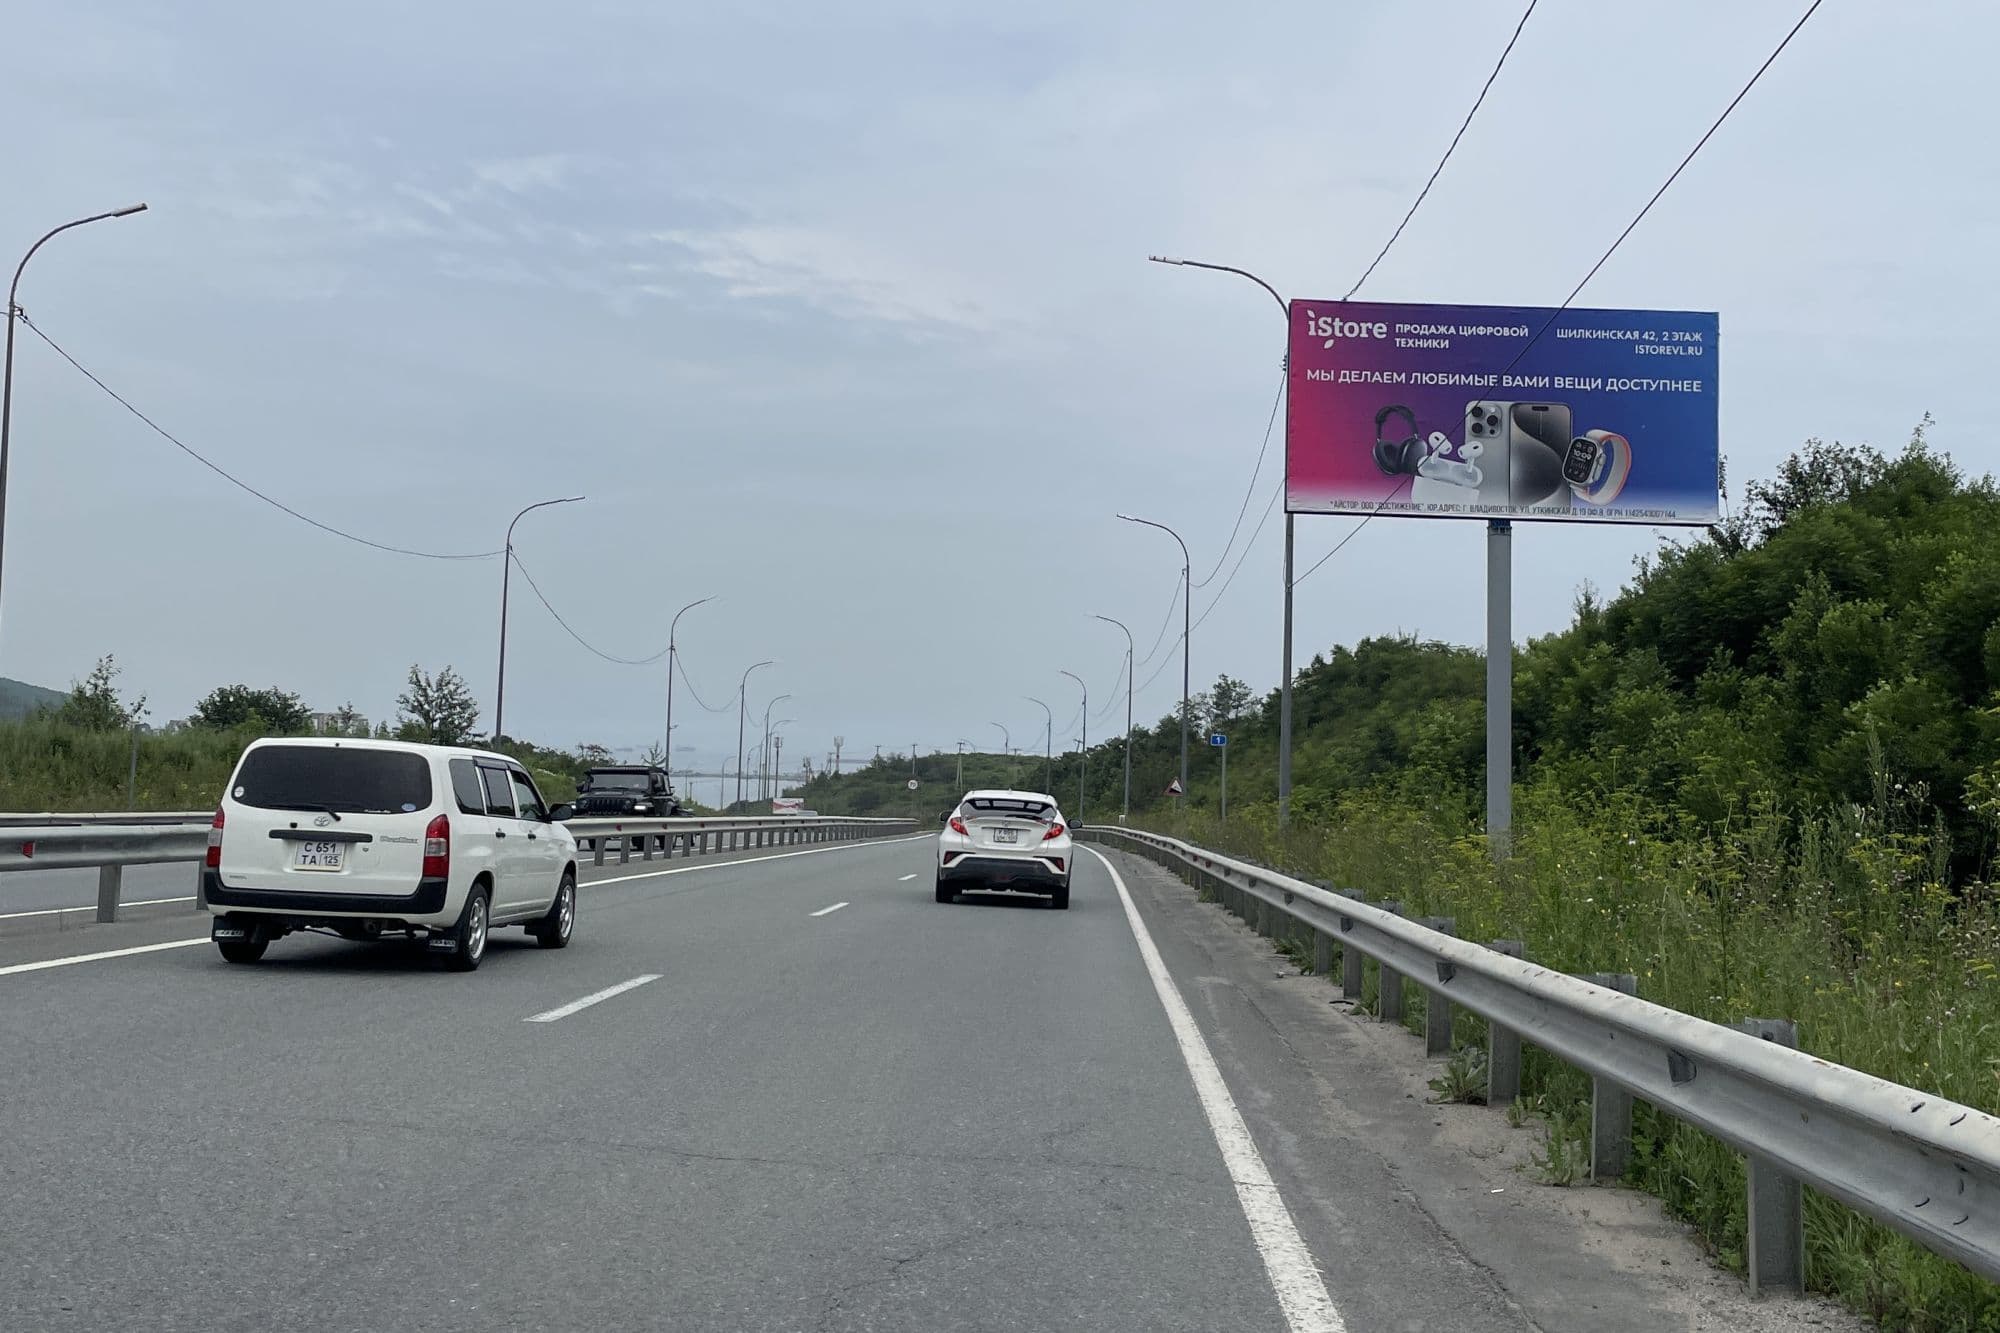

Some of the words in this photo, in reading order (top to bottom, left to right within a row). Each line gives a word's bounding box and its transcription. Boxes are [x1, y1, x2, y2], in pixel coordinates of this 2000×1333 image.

[1307, 310, 1388, 339] iStore
[1395, 323, 1456, 336] ПРОДАЖА
[1459, 324, 1529, 338] ЦИФРОВОЙ
[1556, 328, 1640, 341] ШИЛКИНСКАЯ
[1642, 331, 1659, 343] 42,
[1662, 331, 1670, 342] 2
[1672, 331, 1703, 342] ЭТАЖ
[1395, 338, 1450, 349] ТЕХНИКИ
[1635, 345, 1703, 356] ISTOREVL.RU
[1307, 369, 1335, 382] МЫ
[1338, 370, 1406, 384] ДЕЛАЕМ
[1409, 373, 1498, 387] ЛЮБИМЫЕ
[1502, 375, 1550, 388] ВАМИ
[1554, 377, 1602, 391] ВЕЩИ
[1605, 378, 1703, 393] ДОСТУПНЕЕ
[304, 842, 313, 853] С
[315, 842, 337, 853] 651
[301, 854, 317, 865] ТА
[324, 855, 339, 864] 125
